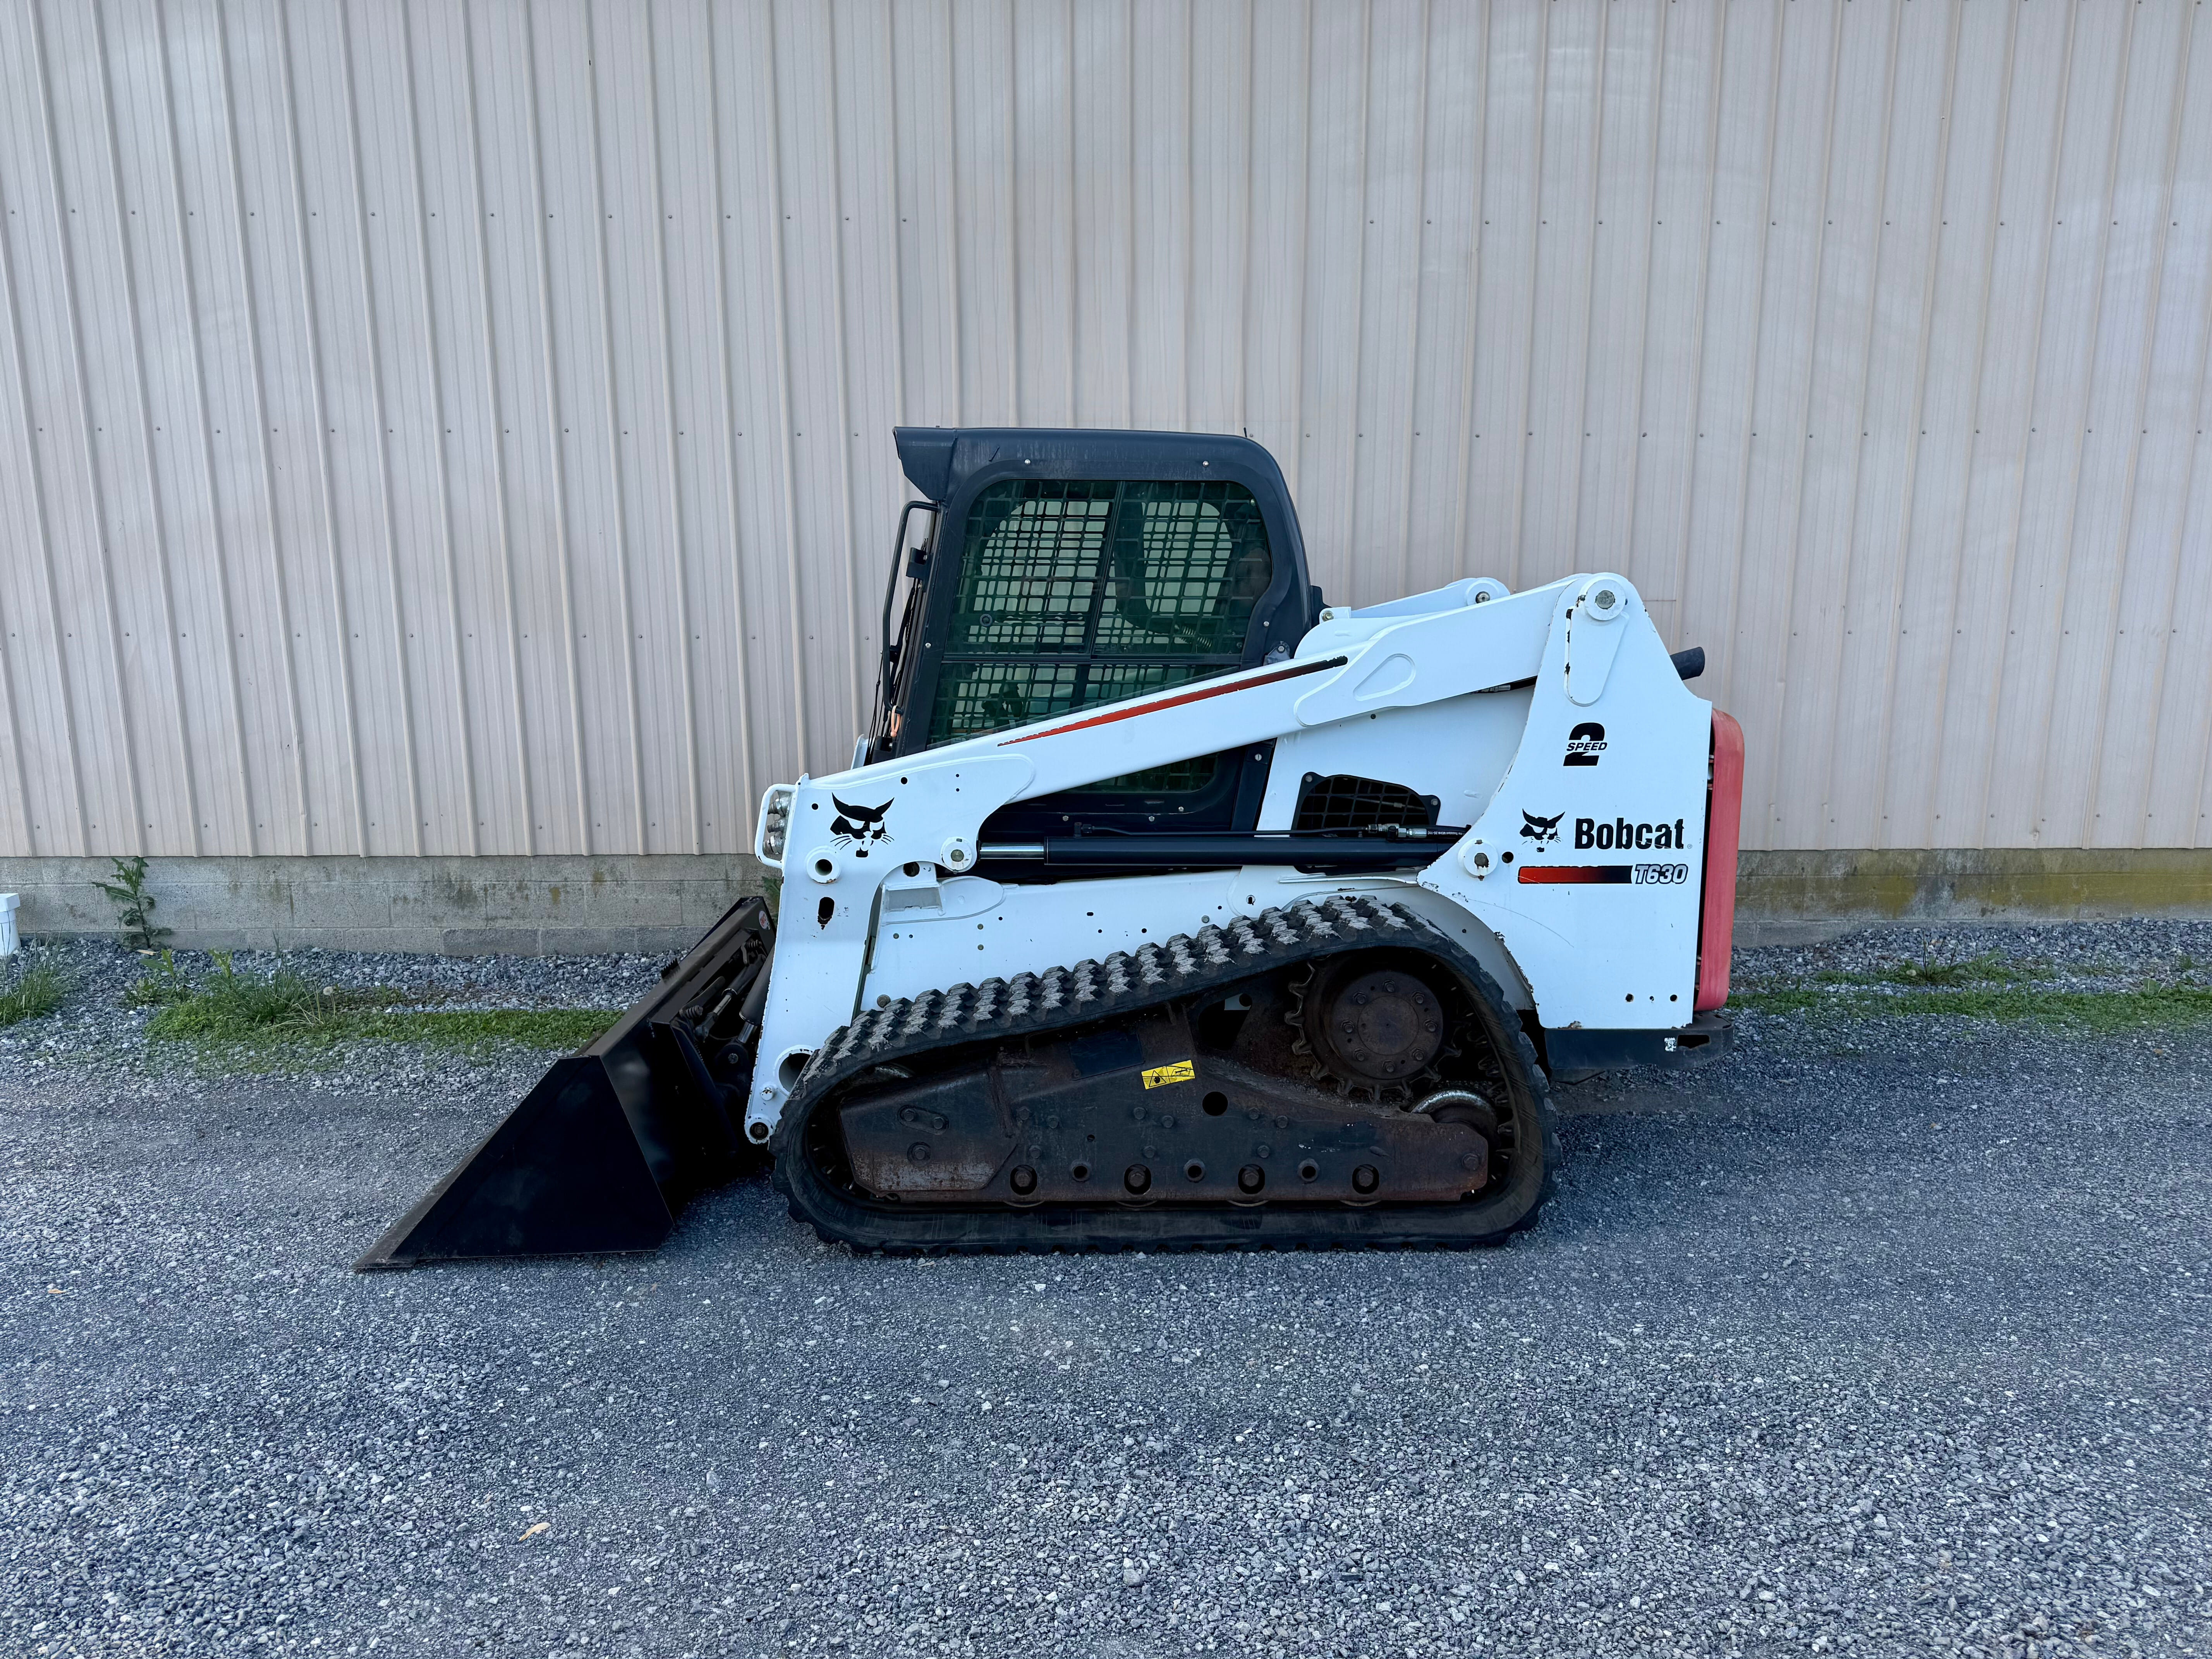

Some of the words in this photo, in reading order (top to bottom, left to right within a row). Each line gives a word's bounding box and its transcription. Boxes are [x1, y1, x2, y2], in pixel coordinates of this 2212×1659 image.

[1563, 722, 1605, 766] 2
[1566, 742, 1607, 751] SPEED
[1575, 817, 1685, 850] Bobcat
[1635, 864, 1688, 884] T630
